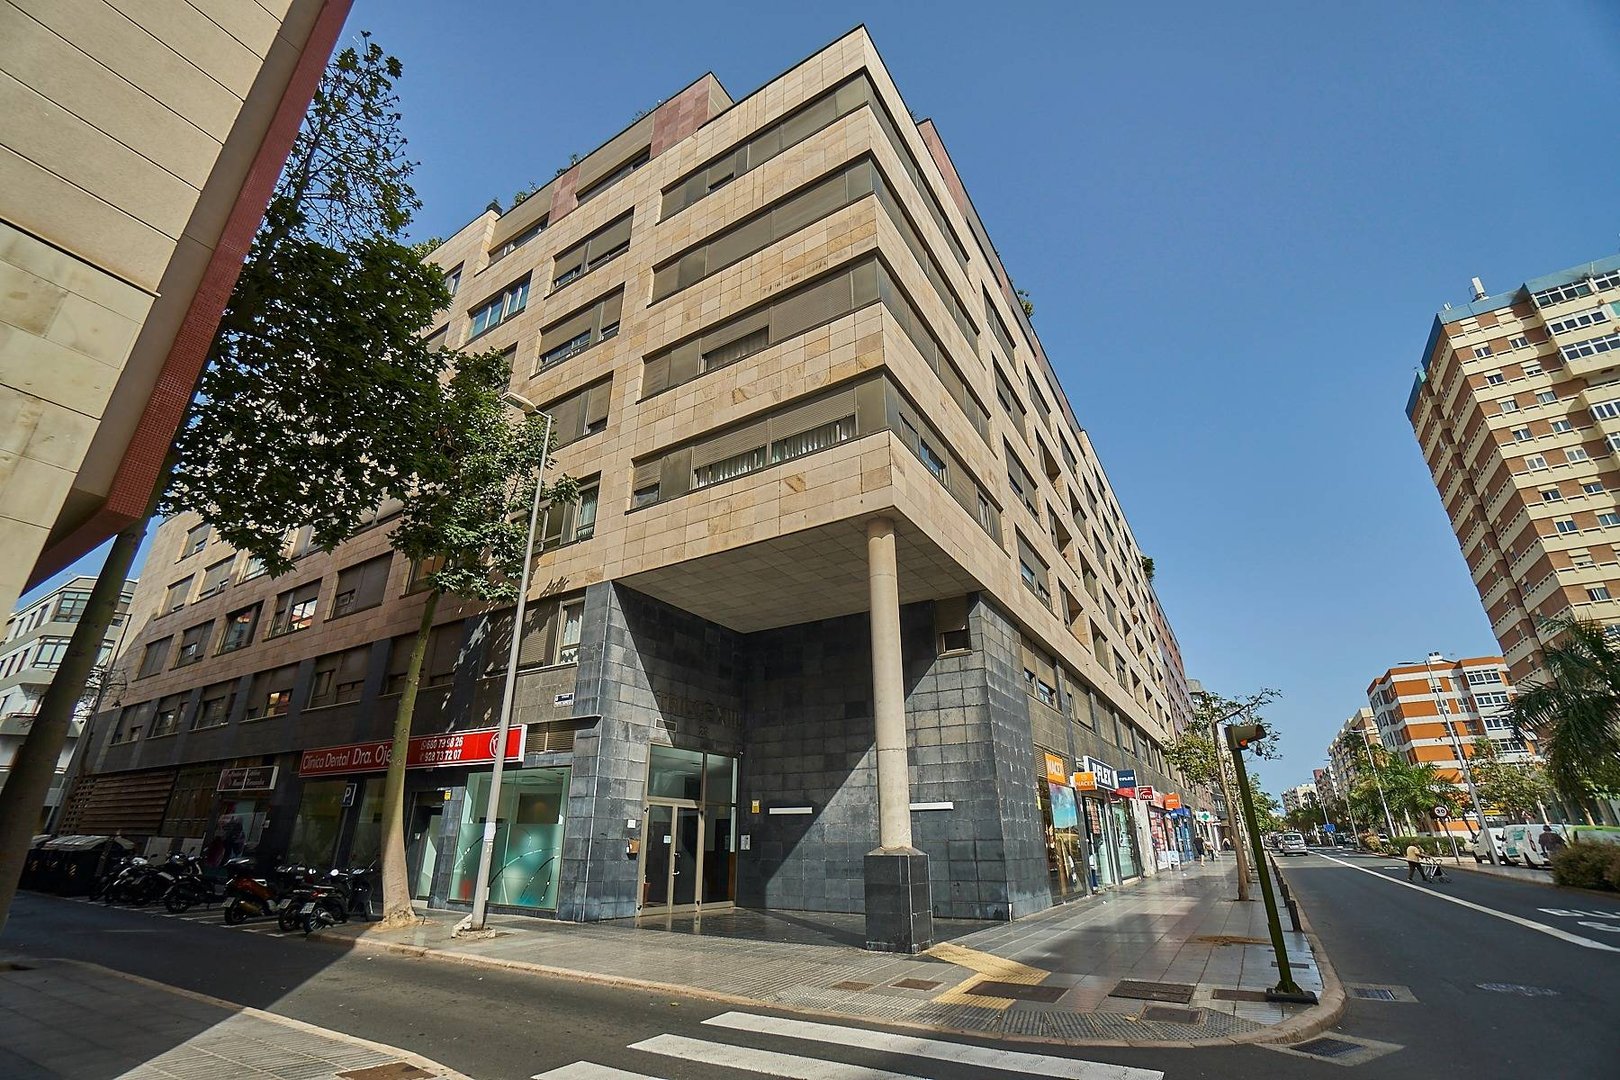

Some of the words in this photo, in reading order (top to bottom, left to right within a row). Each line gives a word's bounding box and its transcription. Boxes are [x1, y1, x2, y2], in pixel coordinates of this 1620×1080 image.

[325, 750, 350, 768] Dental
[352, 748, 372, 765] Dra.
[375, 744, 393, 766] Oje
[343, 786, 352, 803] P
[1536, 908, 1620, 918] BU
